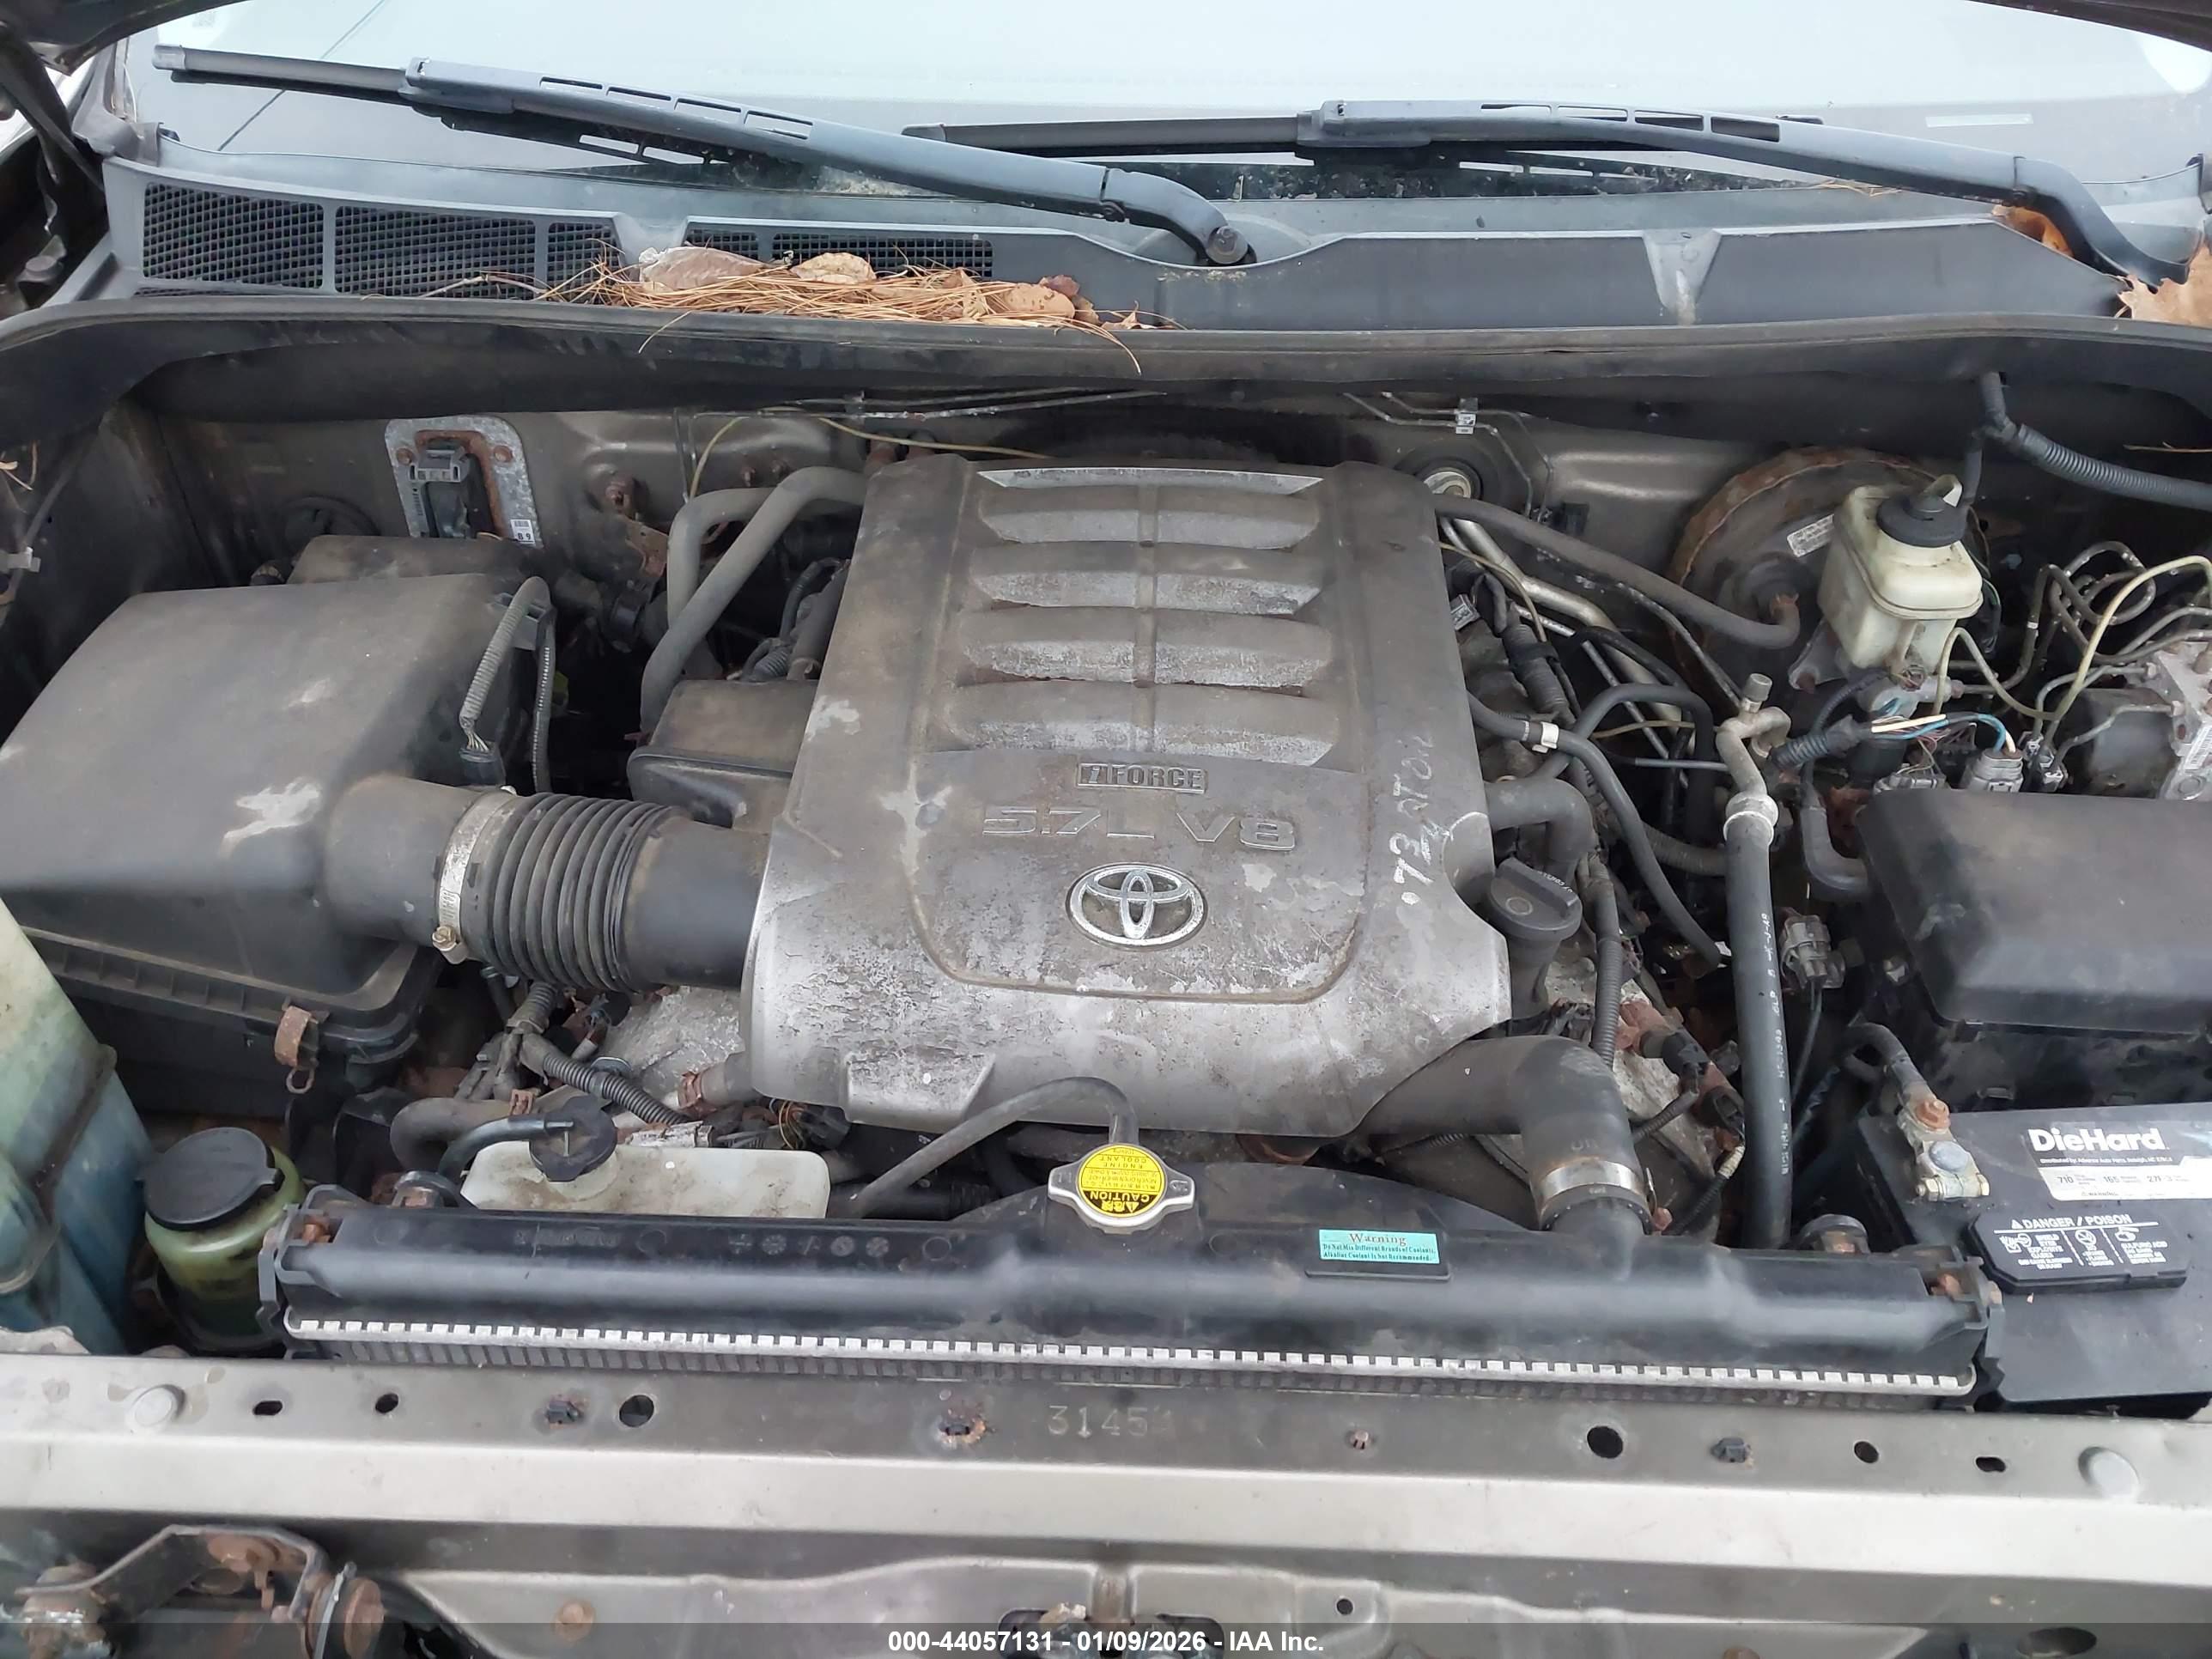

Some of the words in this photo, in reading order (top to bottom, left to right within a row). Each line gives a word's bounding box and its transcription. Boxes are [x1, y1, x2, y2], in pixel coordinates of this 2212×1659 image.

[983, 809, 1156, 839] 5.7L
[1175, 811, 1295, 851] V8
[2027, 1127, 2166, 1152] DieHard
[1099, 1155, 1147, 1164] COOLANT
[2057, 1176, 2075, 1184] 710
[1090, 1191, 1150, 1202] CAUTION
[2022, 1217, 2076, 1230] DANGER
[2084, 1214, 2134, 1226] POISON
[1349, 1233, 1407, 1246] Warning
